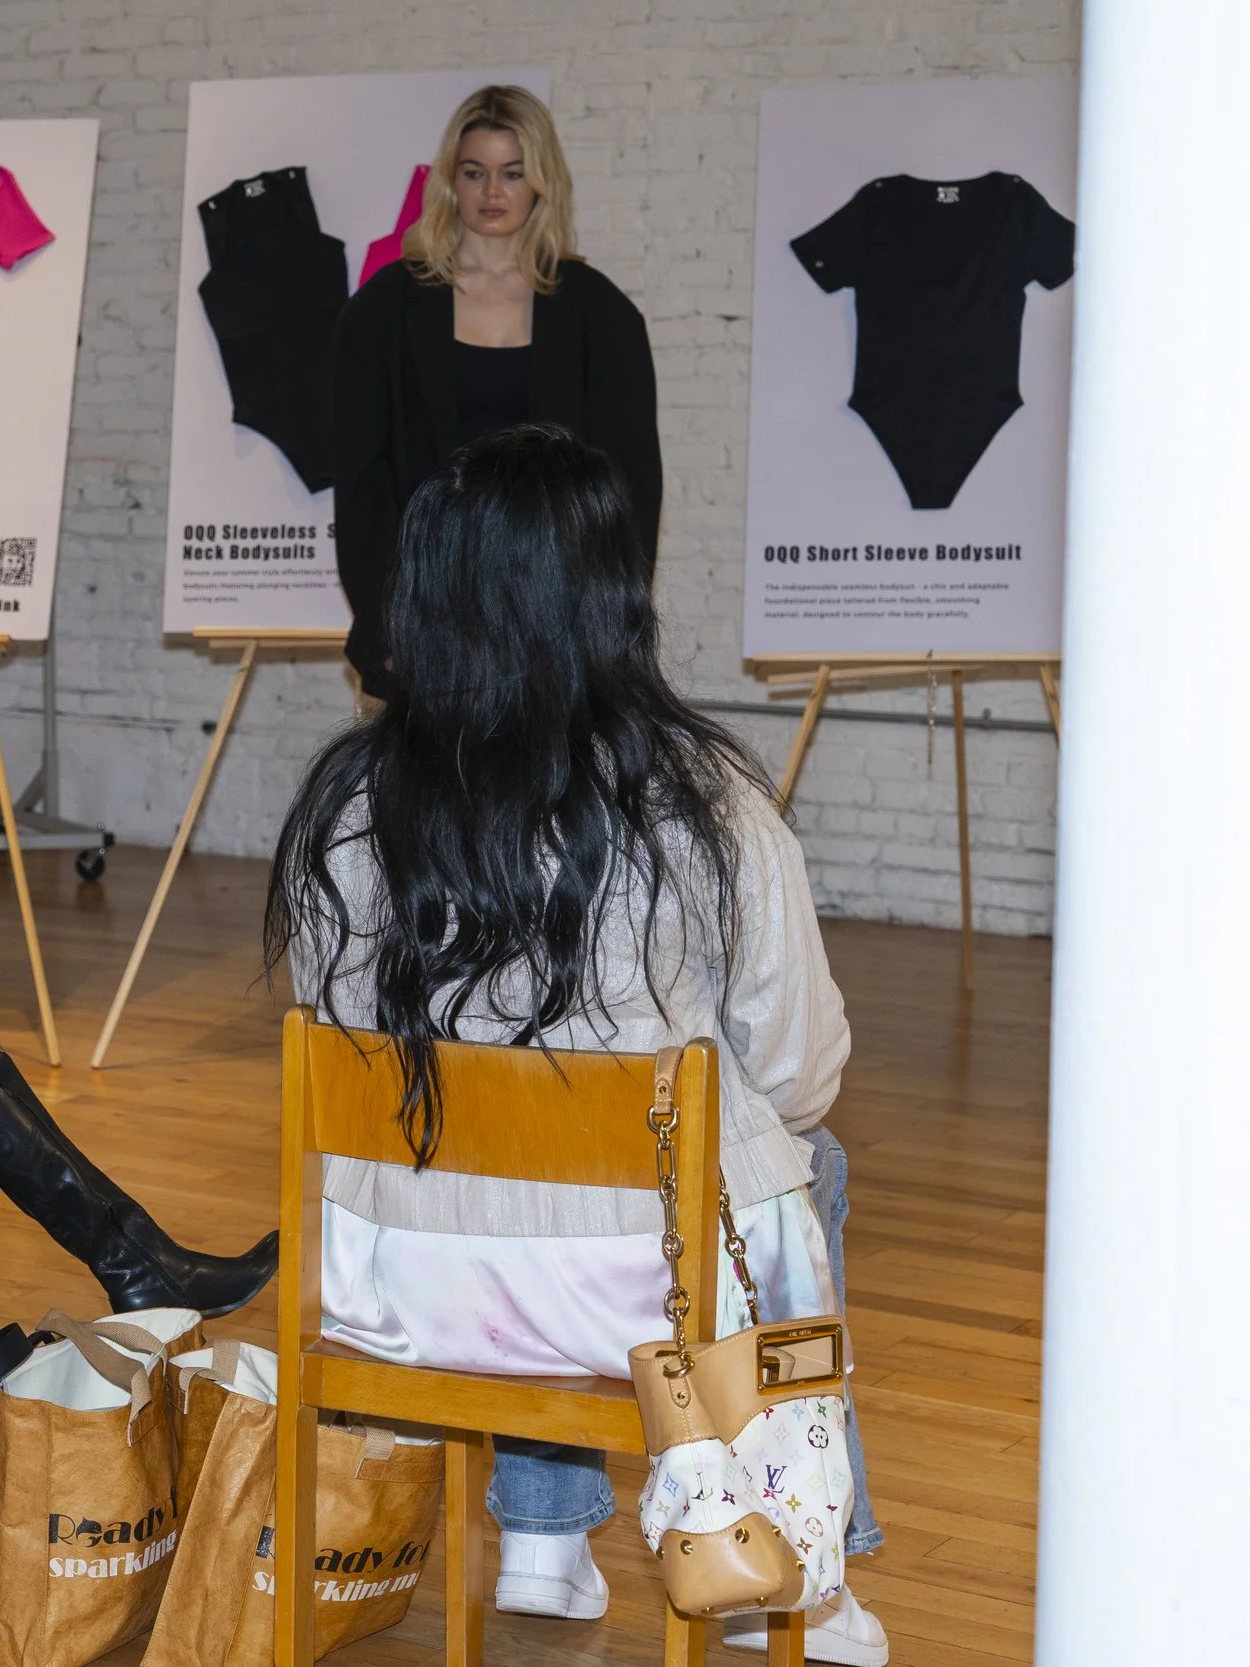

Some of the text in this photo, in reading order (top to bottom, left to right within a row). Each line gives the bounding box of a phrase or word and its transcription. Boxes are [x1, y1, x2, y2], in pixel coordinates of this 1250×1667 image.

[222, 524, 317, 540] Sleeveless
[183, 544, 316, 561] Neck Bodysuits
[807, 545, 858, 562] Short
[864, 545, 929, 562] Sleeve
[936, 544, 1022, 562] Bodysuit
[49, 1529, 178, 1579] sparkling
